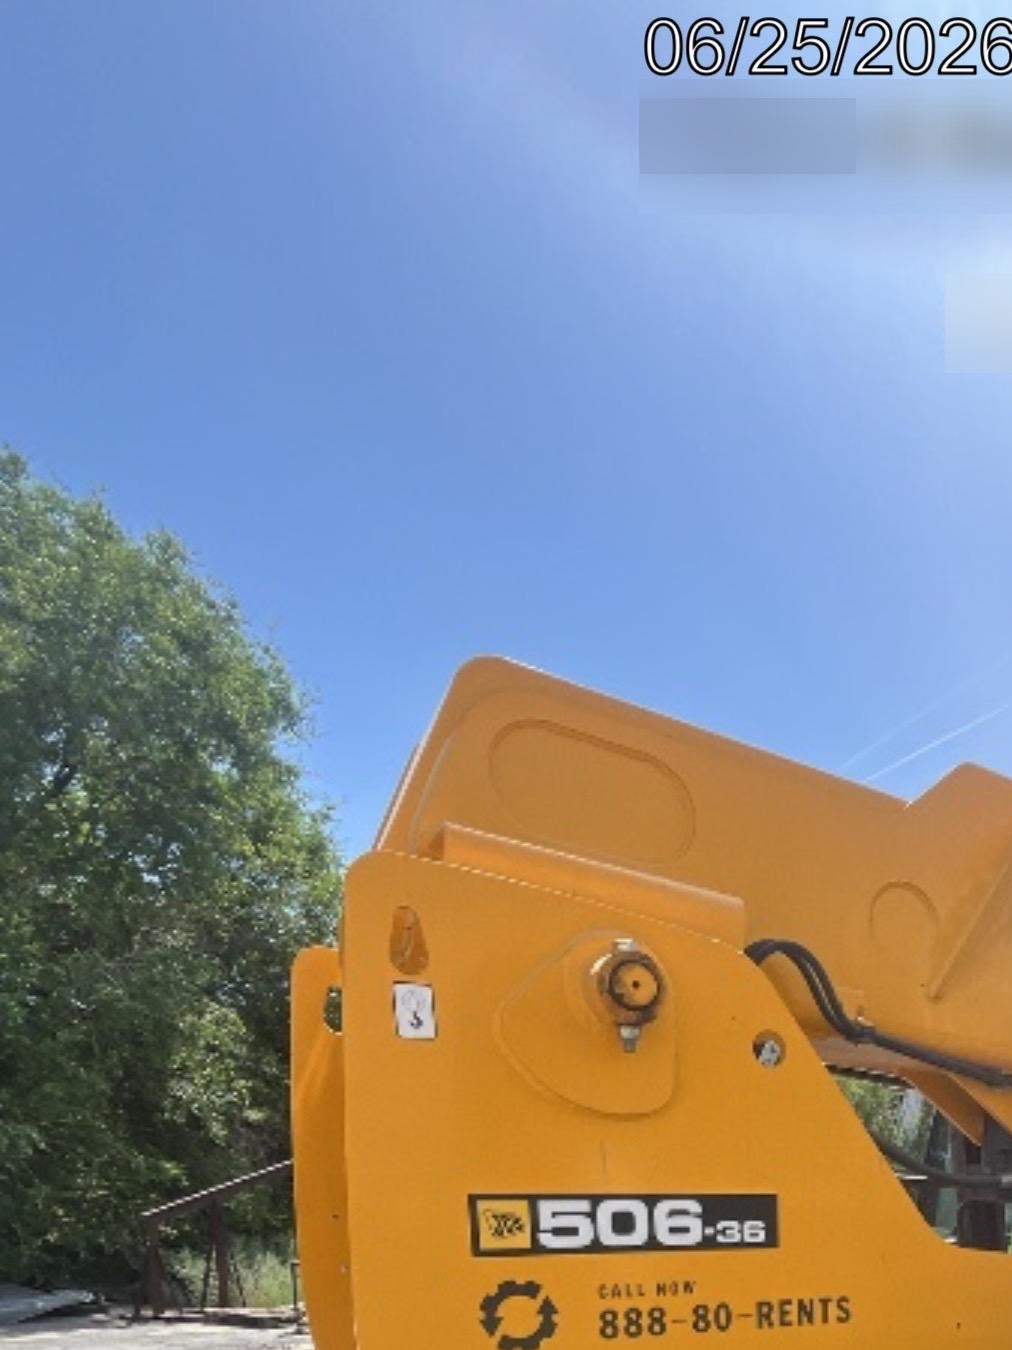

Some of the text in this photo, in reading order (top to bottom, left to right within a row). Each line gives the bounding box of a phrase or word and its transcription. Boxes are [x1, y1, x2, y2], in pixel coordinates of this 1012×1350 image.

[536, 1199, 767, 1249] 506-36
[597, 1280, 698, 1300] CALL NOW
[598, 1297, 853, 1339] 888-80-RENTS
